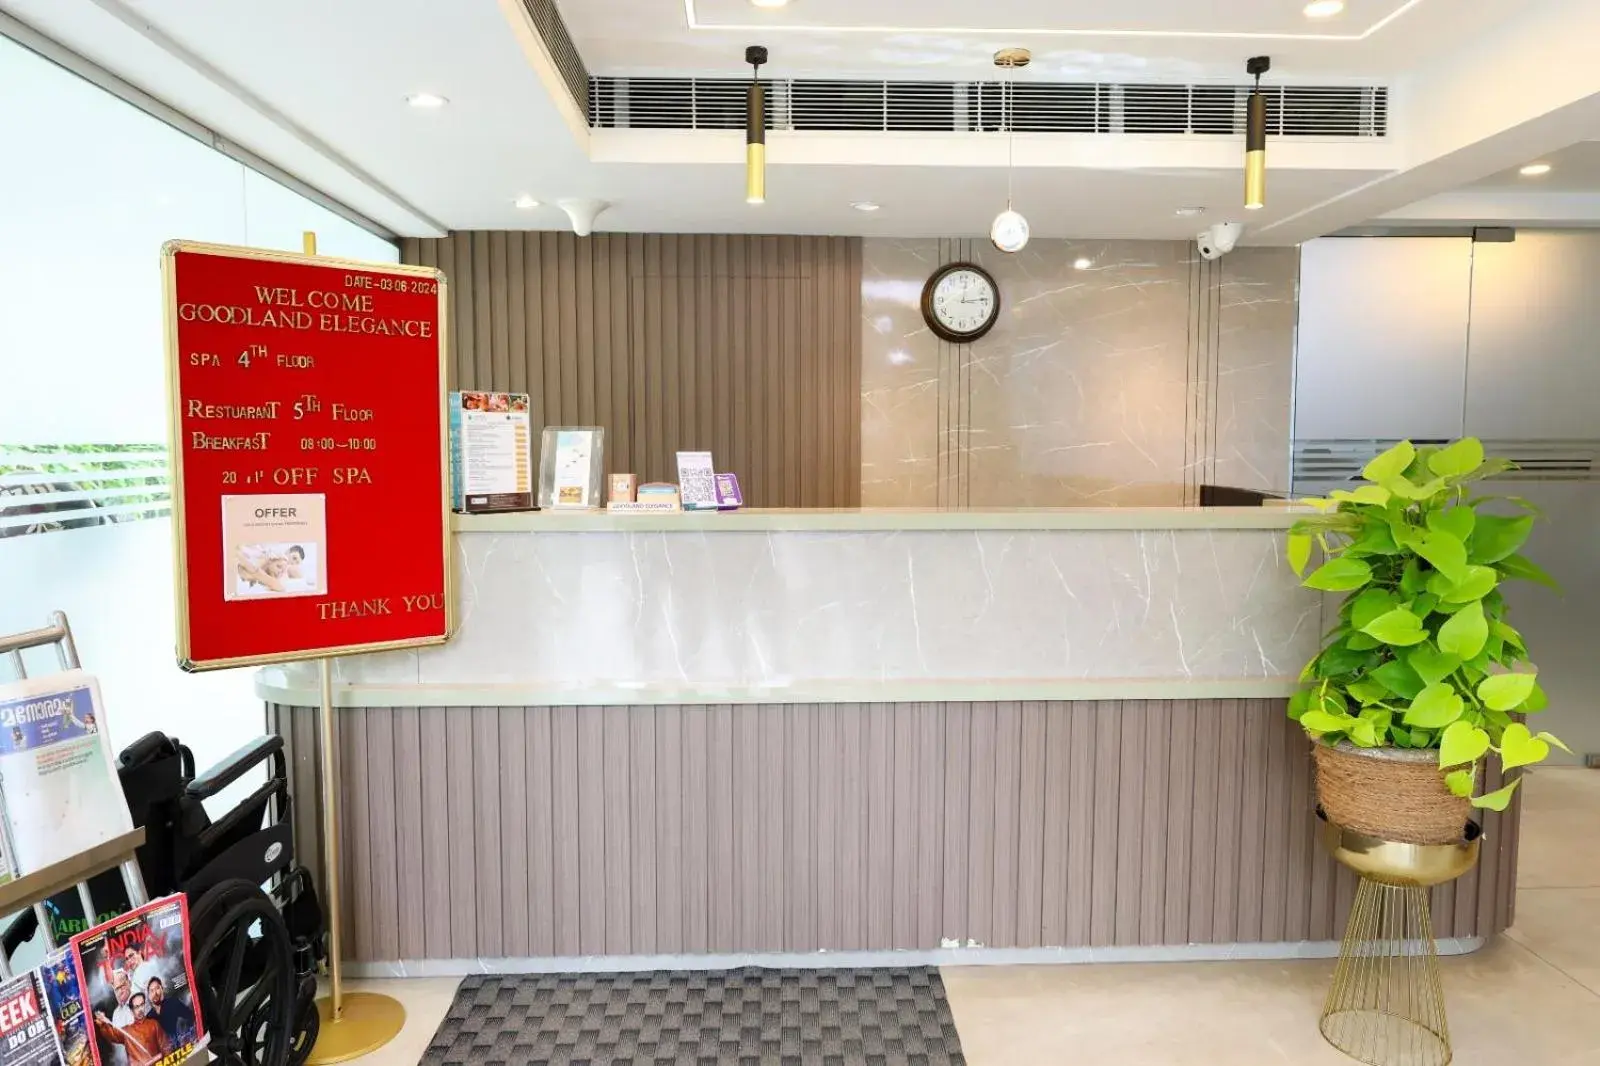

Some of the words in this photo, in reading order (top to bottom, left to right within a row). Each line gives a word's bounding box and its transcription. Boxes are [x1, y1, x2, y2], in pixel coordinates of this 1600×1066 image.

[254, 286, 374, 312] WELCOME
[179, 303, 312, 330] GOODLAND
[320, 314, 432, 338] ELEGANCE
[190, 353, 220, 367] SPA
[277, 355, 315, 368] FLOOR
[273, 468, 318, 485] OFF
[333, 468, 372, 484] SPA
[254, 507, 297, 518] OFFER
[317, 599, 392, 620] THANK
[402, 593, 444, 613] YOU
[8, 1033, 26, 1055] DO
[28, 1019, 46, 1038] OR
